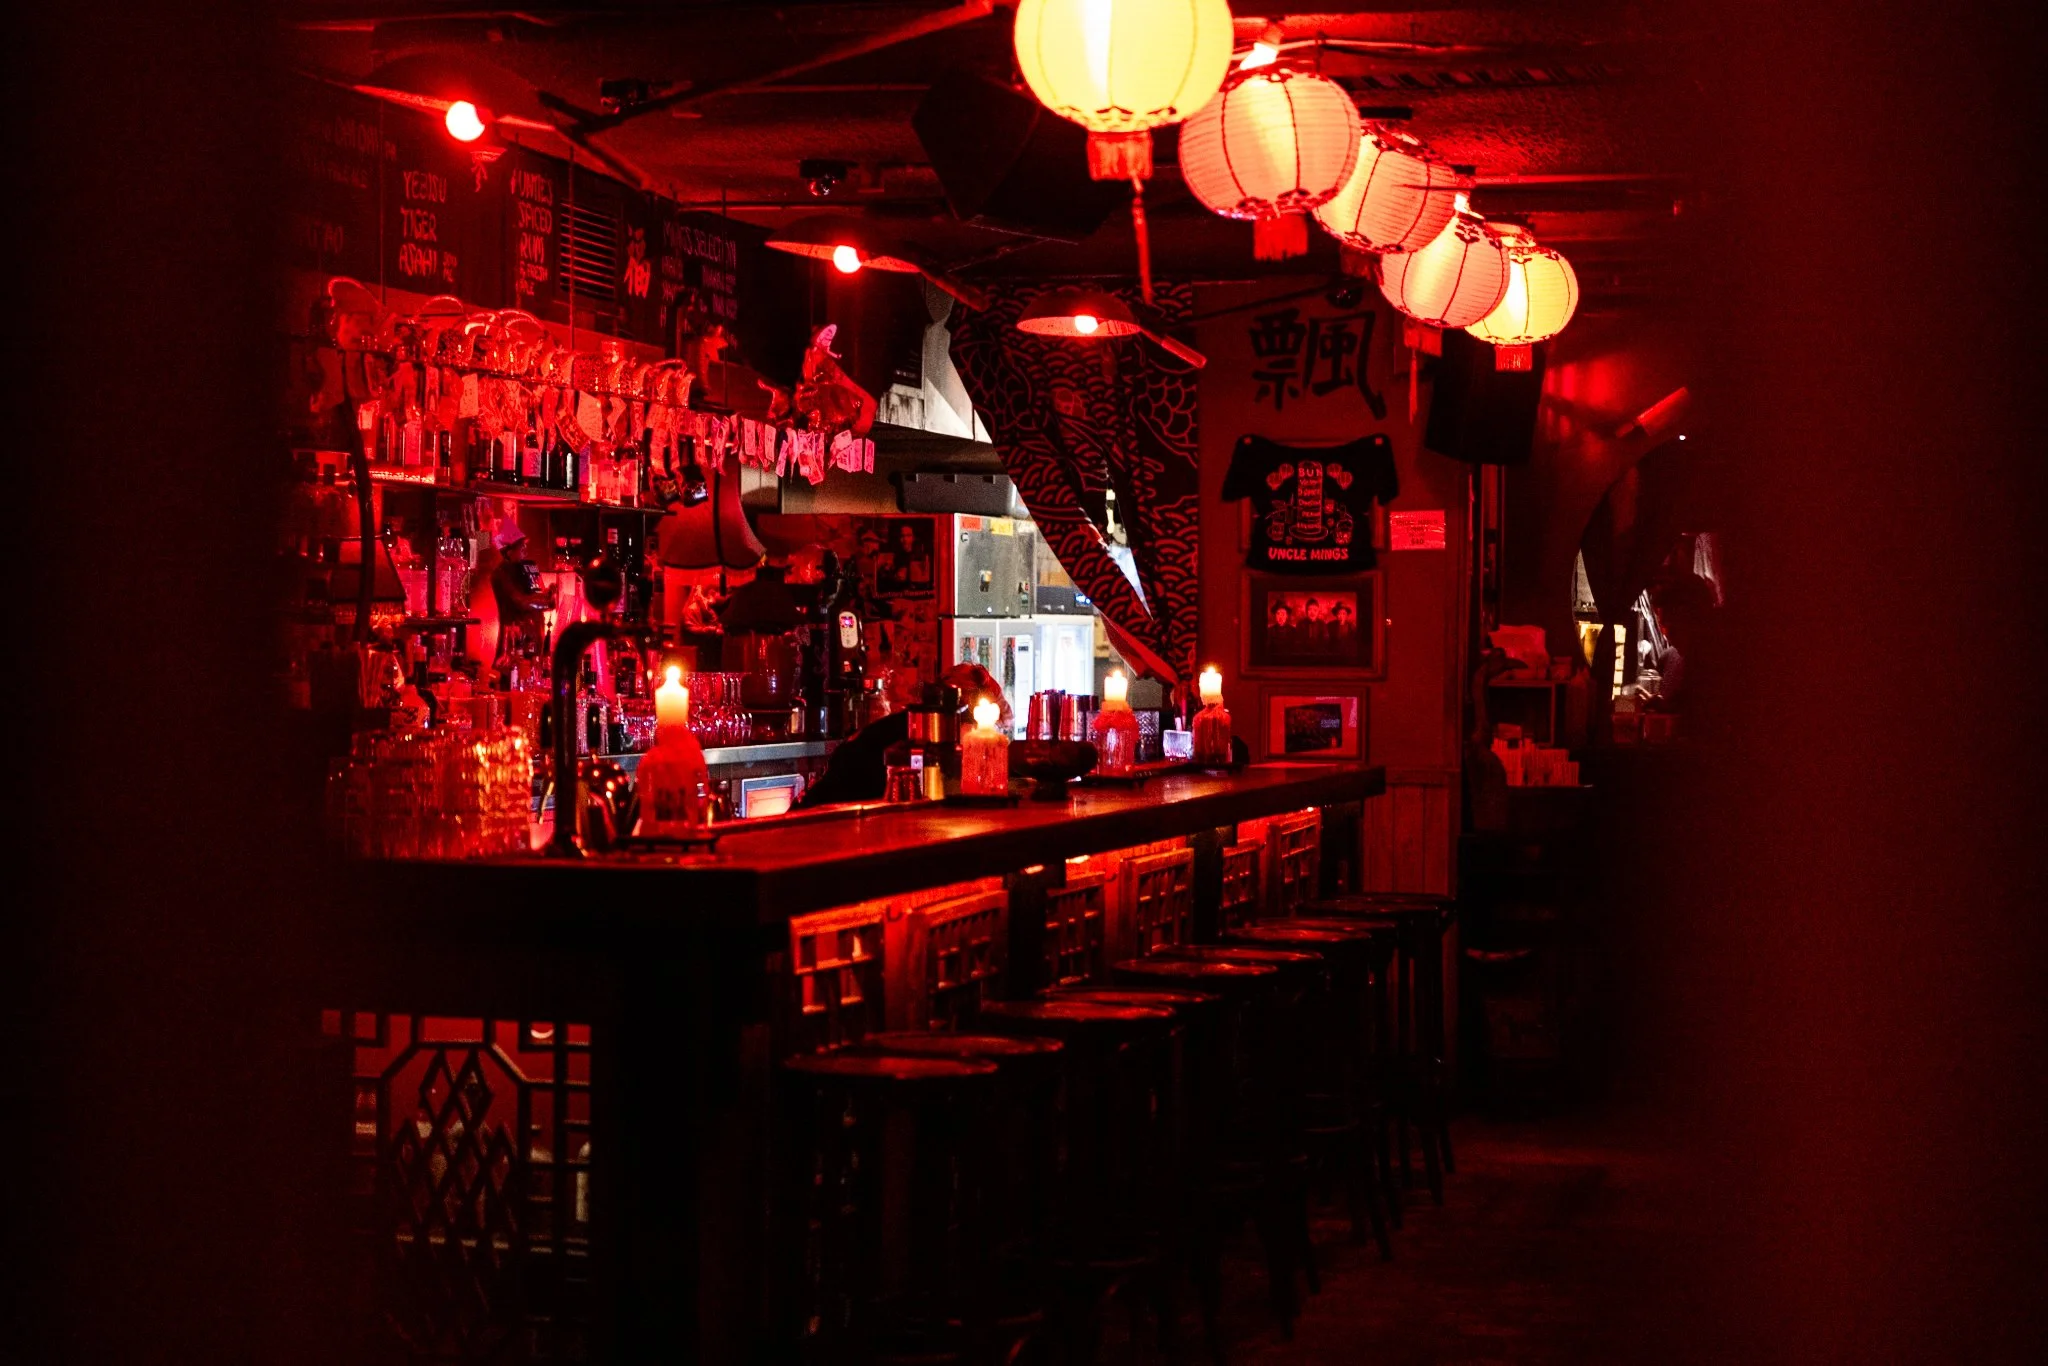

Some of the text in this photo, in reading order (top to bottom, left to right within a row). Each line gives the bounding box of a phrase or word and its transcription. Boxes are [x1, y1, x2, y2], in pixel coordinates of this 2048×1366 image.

[400, 205, 438, 242] TIGER
[398, 242, 438, 277] ASAHI
[518, 231, 545, 264] RUM
[1267, 546, 1349, 560] UNCLE MINGS
